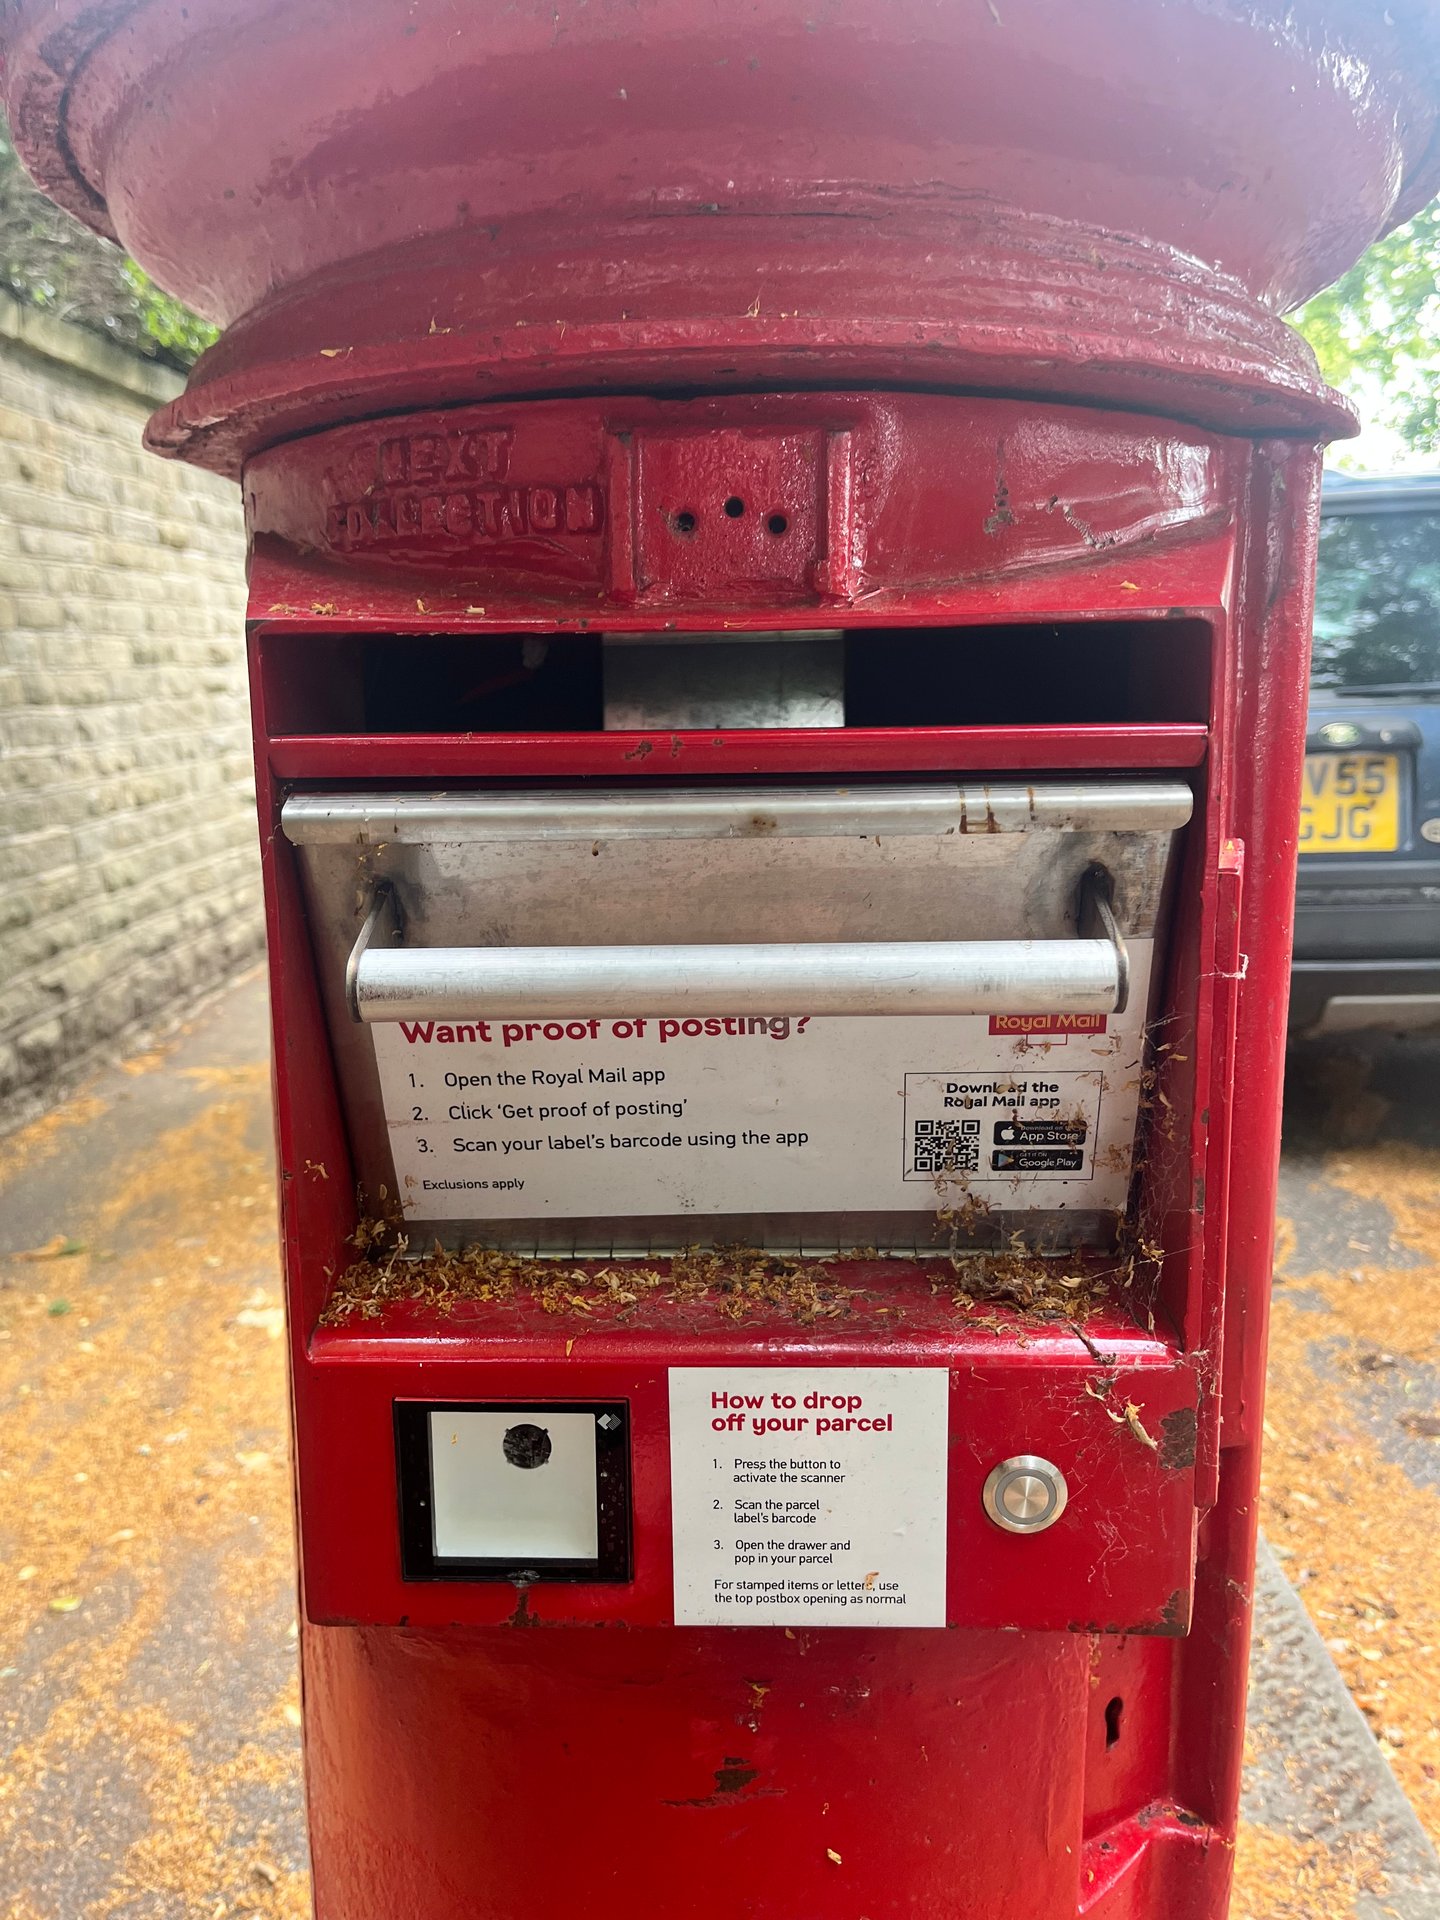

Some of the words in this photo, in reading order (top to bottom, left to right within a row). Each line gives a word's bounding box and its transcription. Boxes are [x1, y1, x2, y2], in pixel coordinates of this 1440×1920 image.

[995, 1015, 1051, 1032] Royal
[1056, 1014, 1100, 1028] Mail
[398, 1021, 493, 1044] Want
[501, 1019, 601, 1048] proof
[611, 1018, 648, 1039] of
[658, 1016, 811, 1043] posting?
[408, 1073, 424, 1088] 1.
[444, 1072, 492, 1090] Open
[496, 1070, 527, 1086] the
[531, 1068, 584, 1088] Royal
[588, 1067, 628, 1084] Mail
[632, 1070, 666, 1086] app
[946, 1082, 1027, 1094] Downlad
[1032, 1081, 1060, 1093] the
[944, 1096, 987, 1109] Royal
[992, 1095, 1025, 1107] Mail
[1030, 1097, 1060, 1109] app
[412, 1106, 429, 1121] 2.
[448, 1101, 493, 1120] Click
[538, 1101, 588, 1121] proof
[592, 1100, 611, 1117] of
[417, 1138, 434, 1153] 3.
[453, 1137, 498, 1153] Scan
[501, 1139, 543, 1155] your
[610, 1131, 683, 1149] barcode
[687, 1131, 736, 1149] using
[741, 1129, 771, 1145] the
[775, 1132, 809, 1148] app
[1020, 1131, 1044, 1141] App
[1047, 1131, 1080, 1140] Store
[1018, 1158, 1055, 1169] Google
[1056, 1158, 1077, 1168] Play
[422, 1179, 489, 1190] Exclusions
[491, 1177, 525, 1191] apply
[711, 1391, 765, 1409] How
[770, 1392, 797, 1410] to
[803, 1391, 863, 1414] drop
[711, 1413, 746, 1432] off
[752, 1417, 810, 1436] your
[816, 1413, 893, 1436] parcel
[712, 1458, 723, 1469] 1.
[734, 1458, 767, 1471] Press
[769, 1458, 788, 1470] the
[789, 1458, 827, 1470] button
[829, 1459, 841, 1470] to
[733, 1471, 777, 1483] activate
[779, 1471, 798, 1483] the
[800, 1474, 846, 1483] scanner
[713, 1499, 723, 1510] 2.
[734, 1499, 762, 1510] Scan
[764, 1498, 783, 1510] the
[785, 1499, 820, 1512] parcel
[771, 1512, 817, 1524] barcode
[713, 1539, 724, 1550] 3.
[735, 1539, 765, 1552] Open
[767, 1539, 785, 1551] the
[787, 1539, 828, 1551] drawer
[829, 1539, 851, 1551] and
[734, 1555, 756, 1566] pop
[758, 1553, 769, 1564] in
[770, 1555, 797, 1566] your
[798, 1552, 833, 1566] parcel
[714, 1579, 734, 1590] For
[736, 1579, 785, 1593] stamped
[787, 1579, 819, 1590] items
[821, 1582, 835, 1590] or
[878, 1582, 899, 1591] use
[714, 1592, 733, 1603] the
[735, 1593, 753, 1606] top
[755, 1592, 800, 1606] postbox
[802, 1593, 847, 1607] opening
[849, 1595, 864, 1604] as
[865, 1593, 907, 1604] normal
